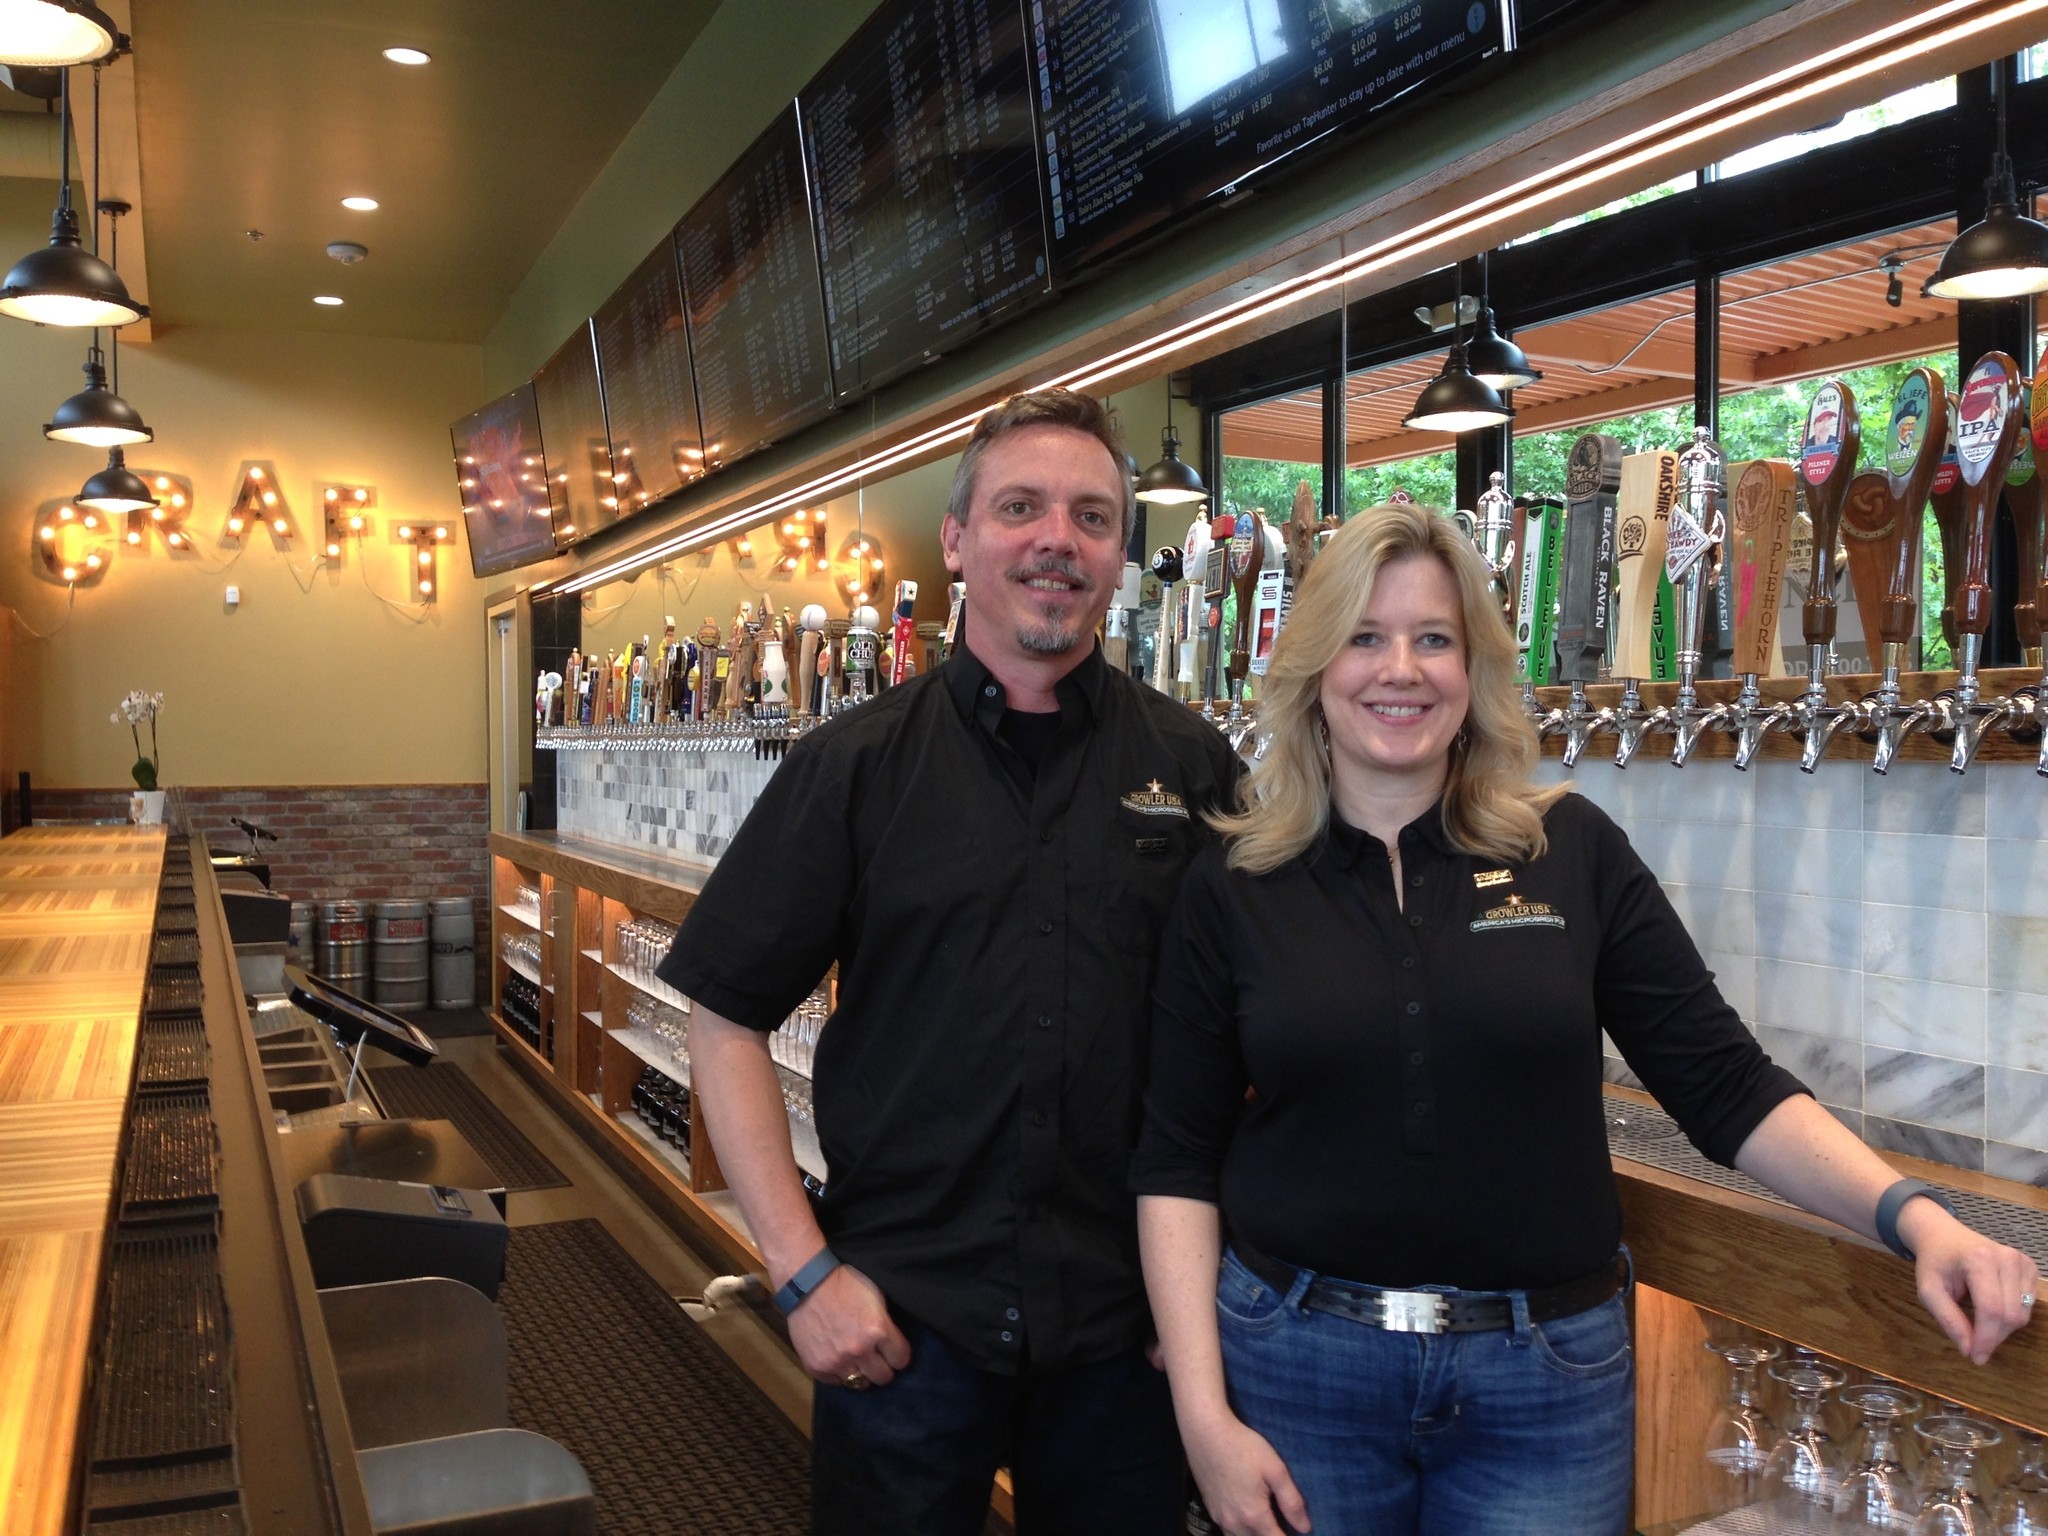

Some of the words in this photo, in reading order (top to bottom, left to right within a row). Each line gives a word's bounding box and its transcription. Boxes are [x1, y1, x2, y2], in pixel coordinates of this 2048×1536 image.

[1394, 4, 1422, 30] $18.00
[1311, 30, 1331, 50] $6.00
[1351, 32, 1378, 56] $10.00
[1314, 58, 1334, 78] $6.00
[1074, 85, 1099, 109] Specialty
[1228, 83, 1242, 101] ABV
[1256, 133, 1283, 154] Favorite
[1283, 128, 1292, 140] us
[1292, 124, 1302, 135] on
[1302, 102, 1338, 132] TapHunter
[1339, 97, 1348, 108] to
[1348, 88, 1364, 105] stay
[1364, 84, 1375, 99] up
[1376, 76, 1385, 89] to
[1386, 66, 1404, 85] date
[1405, 56, 1424, 76] with
[1424, 47, 1440, 61] our
[1440, 32, 1466, 51] menu
[1230, 110, 1246, 127] ABV
[1224, 186, 1236, 196] TCL
[1959, 418, 2000, 438] IPA
[1808, 459, 1830, 468] PILSNER
[1888, 450, 1917, 461] WEIZEN
[1570, 472, 1598, 488] BLACK
[1809, 468, 1826, 476] STYLE
[1654, 456, 1674, 522] OAKSHIRE
[40, 464, 455, 603] CRAFT
[1602, 506, 1612, 562] BLACK
[1755, 489, 1790, 666] TRIPLEHORN
[1521, 574, 1530, 615] SCOTCH
[1596, 570, 1608, 629] RAVEN
[1538, 536, 1556, 679] BELLEVUE
[853, 641, 874, 650] OLD
[1130, 794, 1166, 806] GROWLER
[1166, 795, 1182, 806] USA
[1486, 906, 1528, 920] GROWLER
[1531, 905, 1550, 914] USA
[1473, 918, 1511, 928] AMERICA'S
